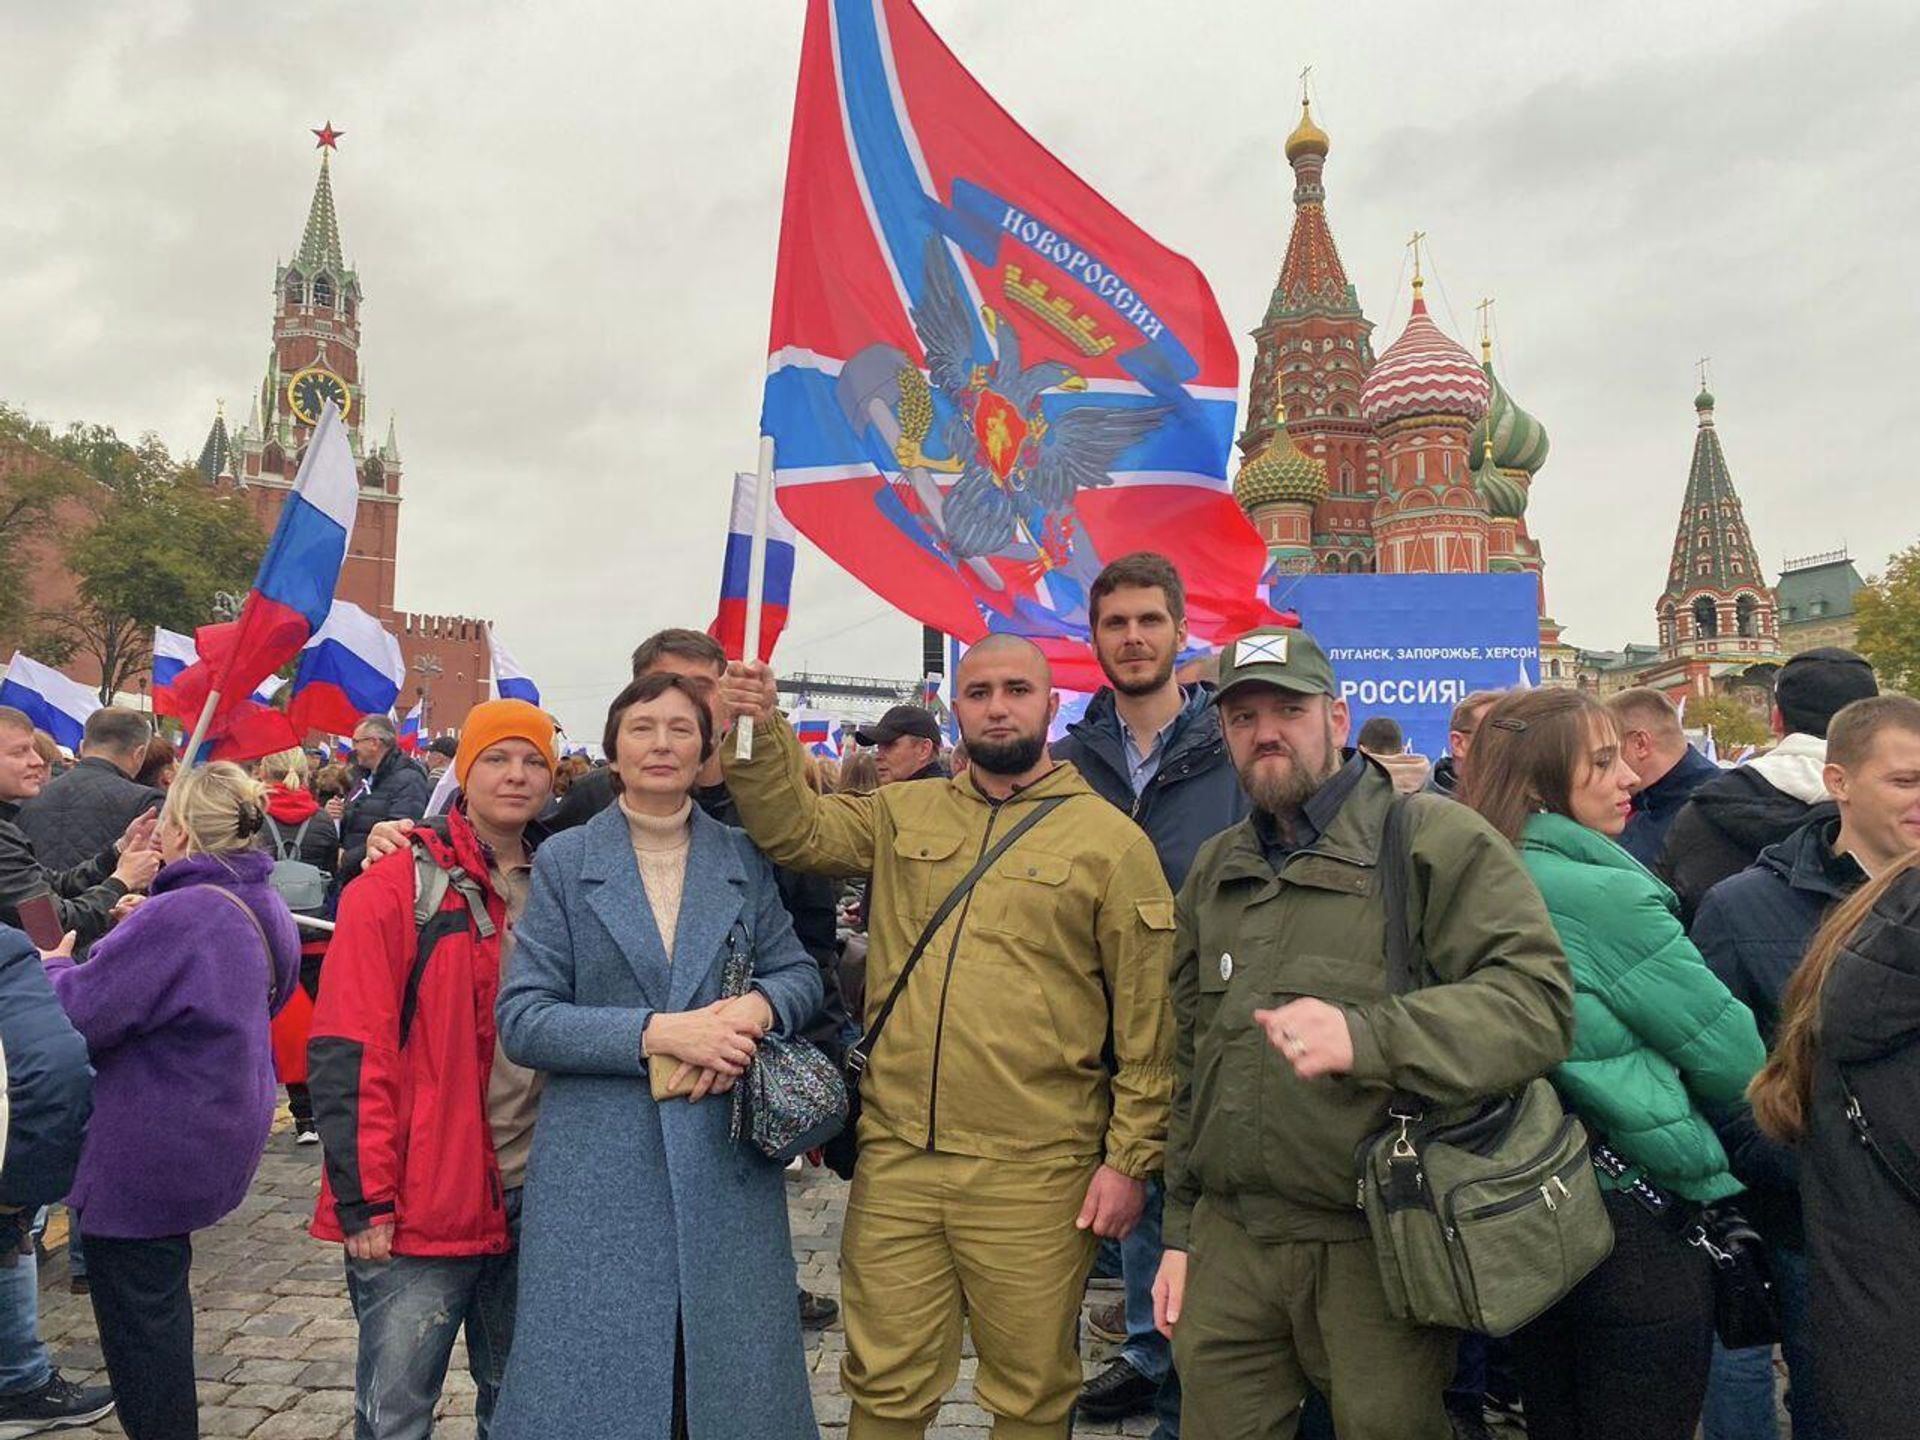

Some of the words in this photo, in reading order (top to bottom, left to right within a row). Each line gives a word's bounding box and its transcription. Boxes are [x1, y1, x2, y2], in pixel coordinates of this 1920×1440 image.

[1001, 207, 1164, 340] НОВОРОССИЯ
[1329, 648, 1393, 661] ЛУГАНСК,
[1485, 648, 1537, 659] ХЕРСОН
[1340, 680, 1465, 704] РОССИЯ!
